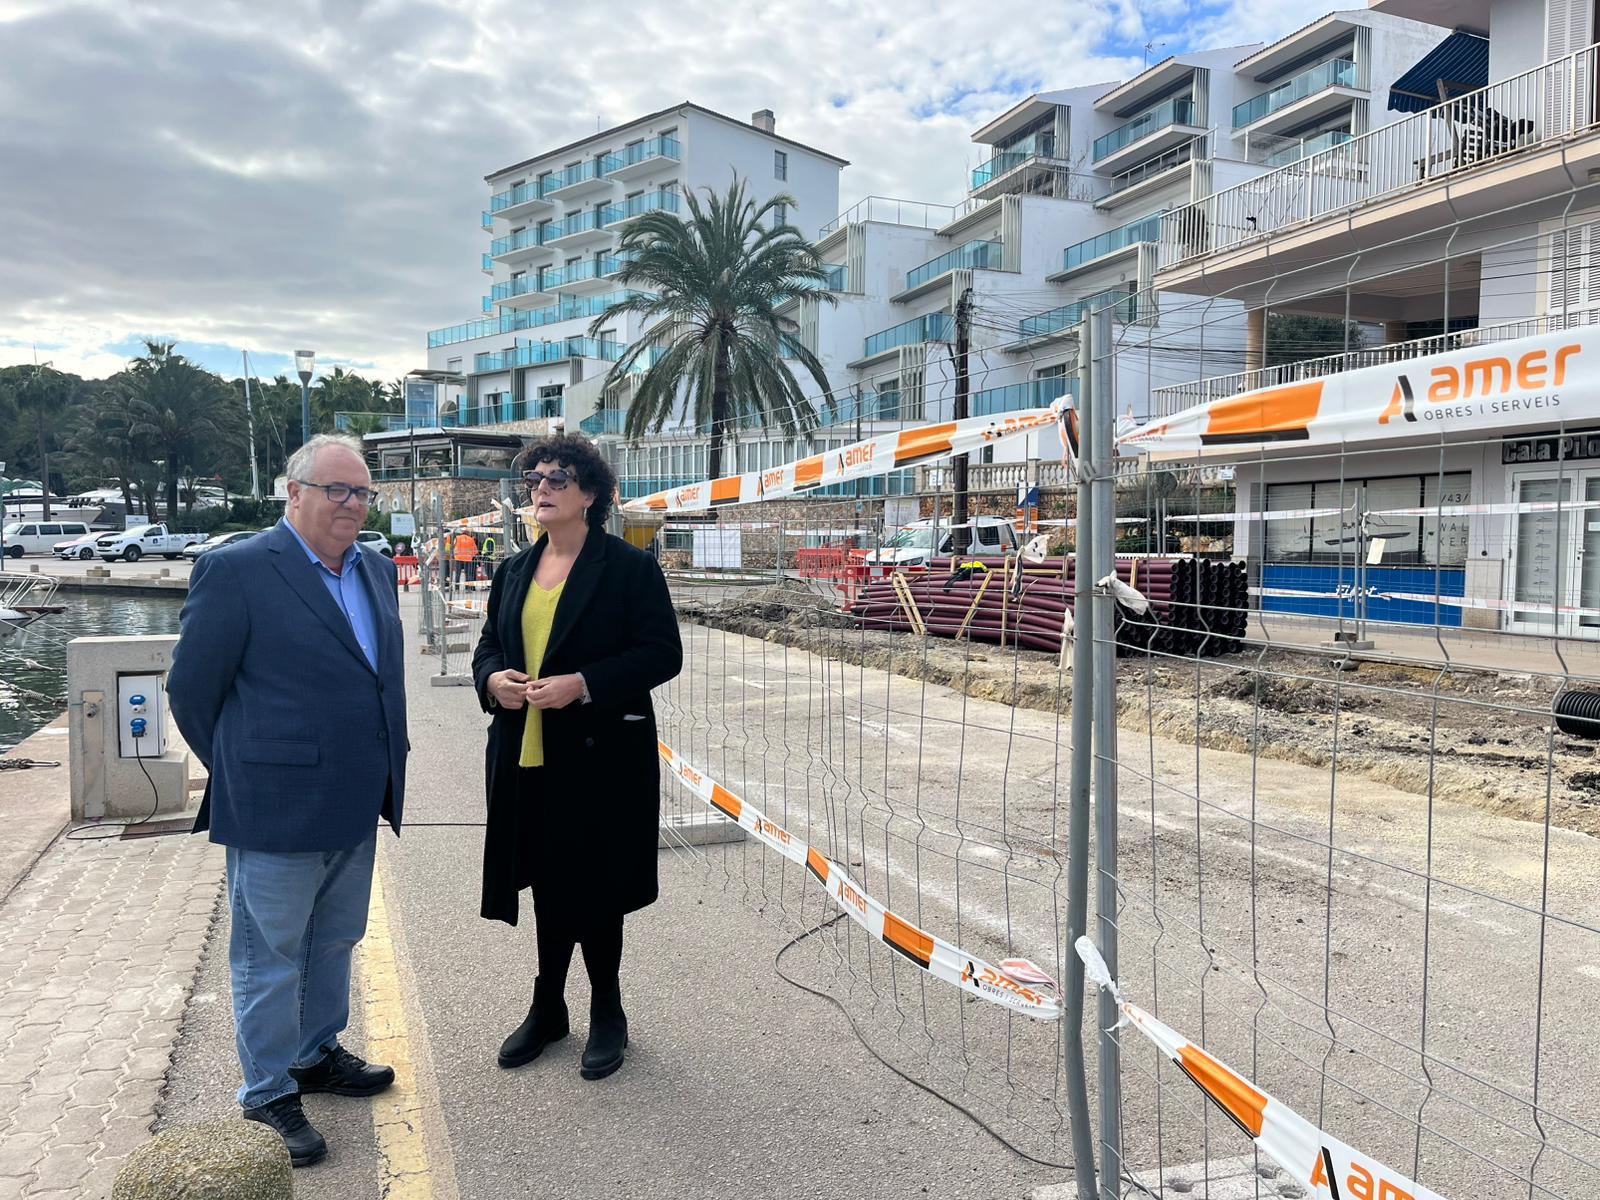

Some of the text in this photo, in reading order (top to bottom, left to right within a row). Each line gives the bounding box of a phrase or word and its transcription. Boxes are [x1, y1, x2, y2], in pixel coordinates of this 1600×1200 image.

[1427, 344, 1582, 403] amer
[1424, 394, 1560, 421] OBRES I SERVEIS
[845, 442, 877, 467] amer
[1503, 438, 1551, 462] Cala
[764, 470, 784, 487] amer
[763, 818, 791, 846] amer
